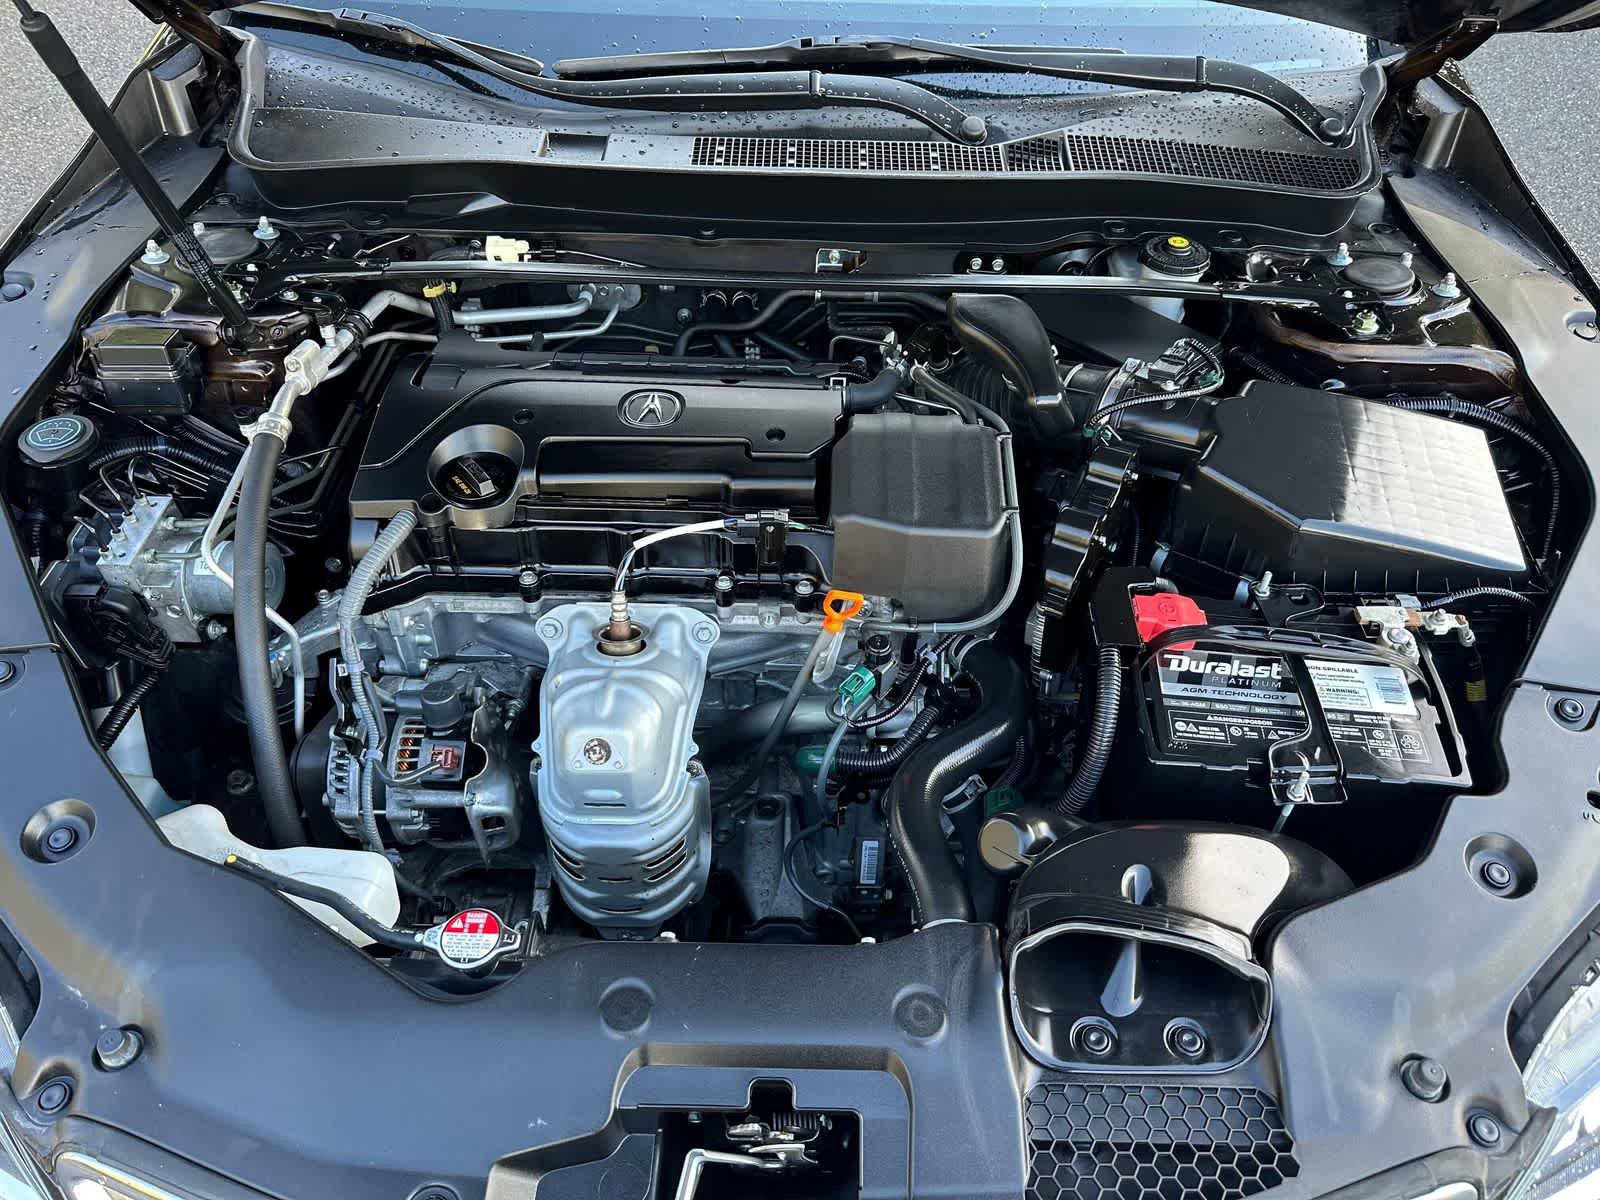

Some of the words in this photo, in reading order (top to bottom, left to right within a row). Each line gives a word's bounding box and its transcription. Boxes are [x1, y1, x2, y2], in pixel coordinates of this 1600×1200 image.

[1163, 654, 1283, 680] Duralast
[1211, 676, 1282, 688] PLATINUM
[1181, 687, 1208, 695] AGM
[1211, 689, 1288, 701] TECHNOLOGY
